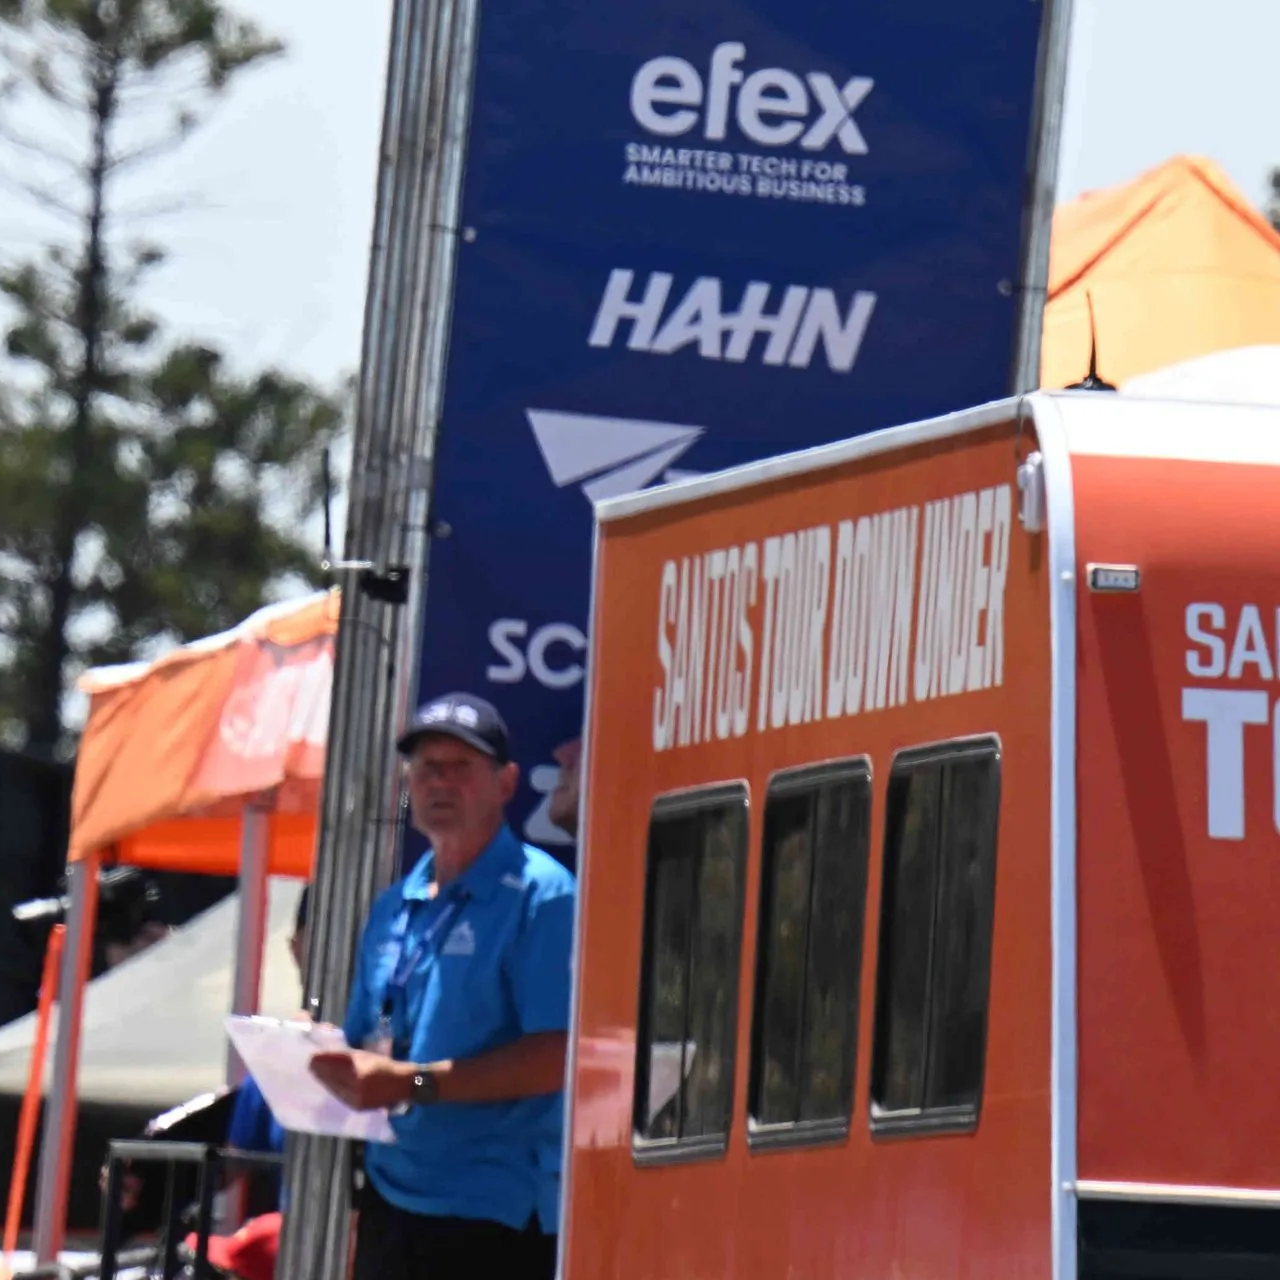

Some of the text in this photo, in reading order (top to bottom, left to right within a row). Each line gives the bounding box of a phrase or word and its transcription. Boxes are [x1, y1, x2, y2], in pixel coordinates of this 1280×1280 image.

[630, 41, 875, 156] efex
[622, 164, 867, 207] AMBITIOUS BUSINESS
[625, 142, 848, 182] SMARTER TECH FOR
[588, 267, 877, 373] HAHN
[653, 483, 1011, 752] SANTOS TOUR DOWN UNDER
[1185, 602, 1280, 681] SA
[1181, 687, 1280, 841] T
